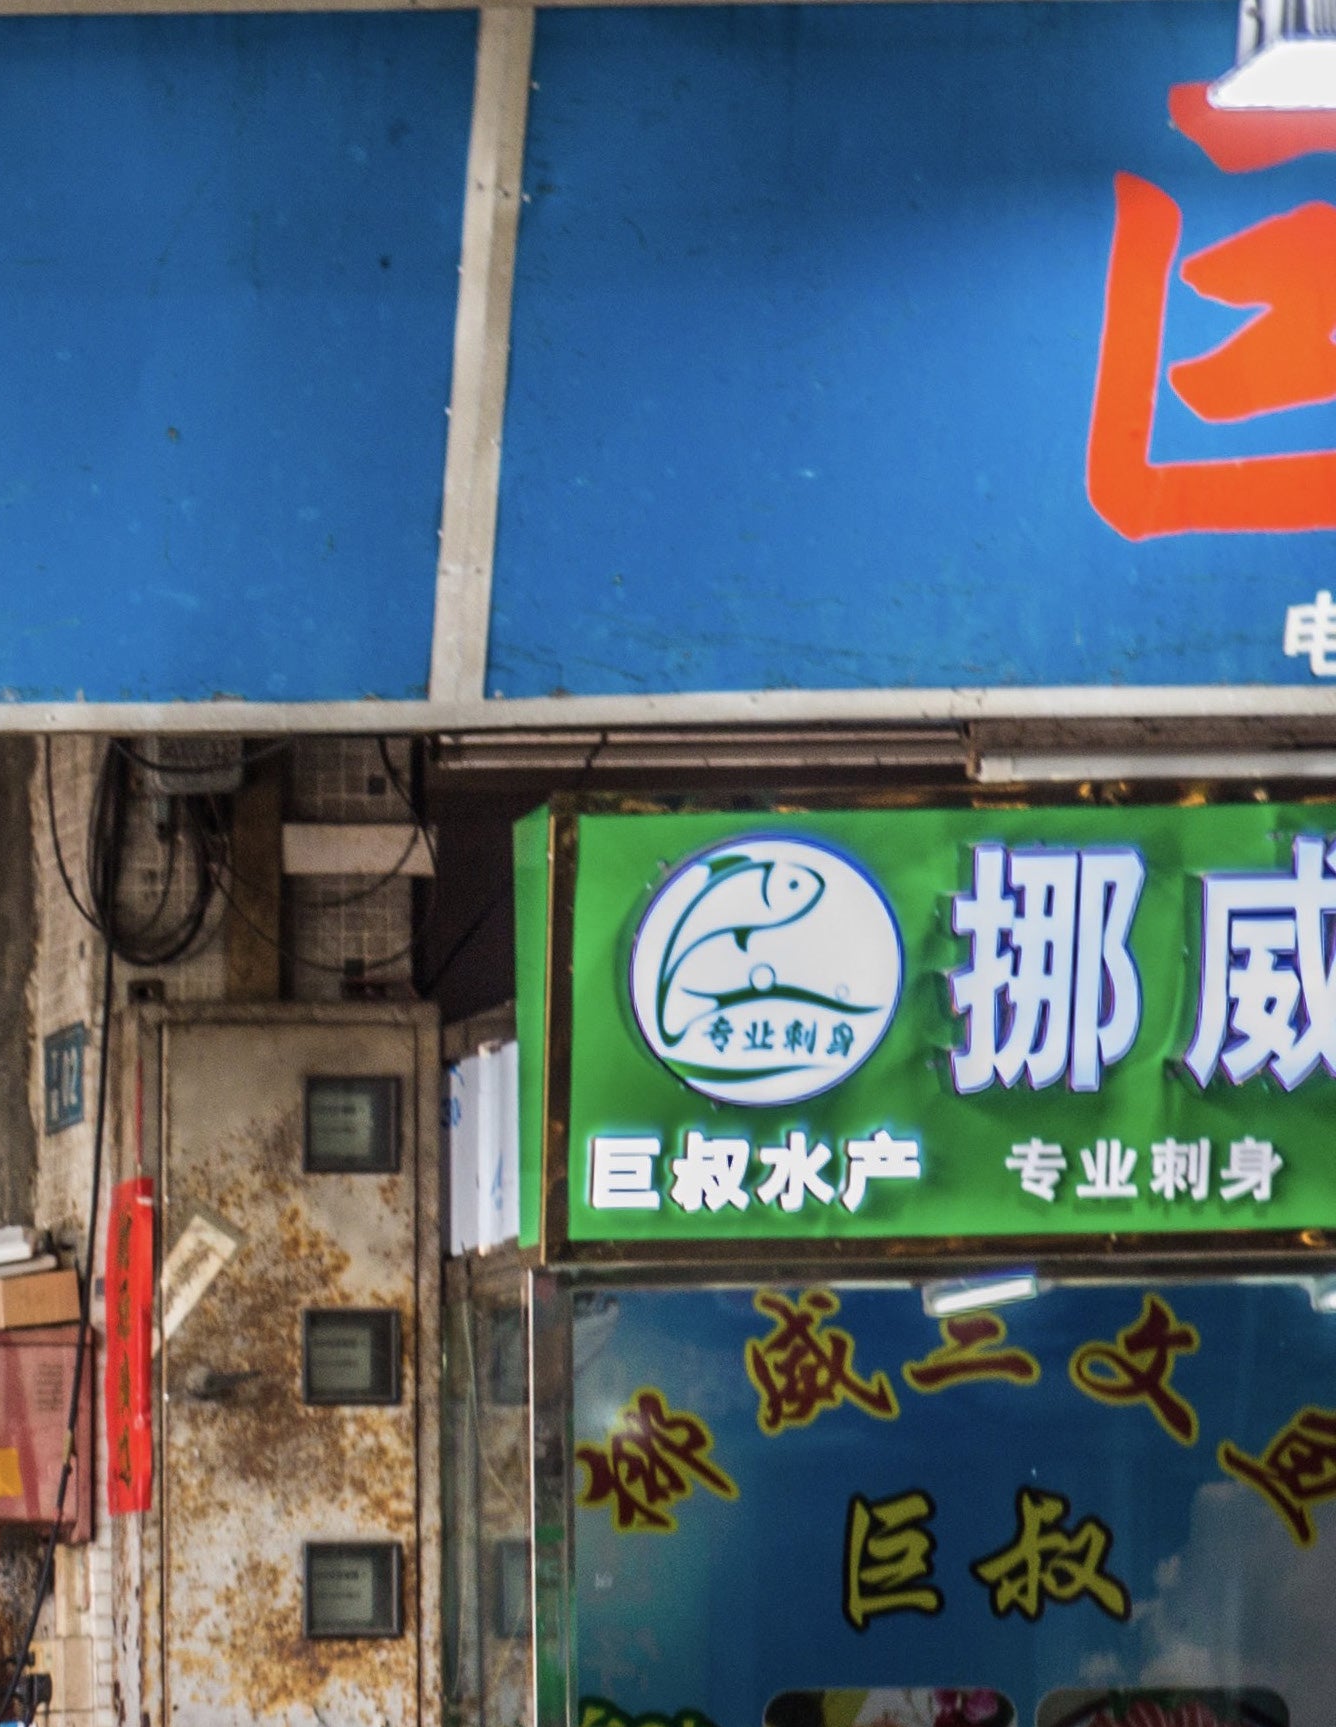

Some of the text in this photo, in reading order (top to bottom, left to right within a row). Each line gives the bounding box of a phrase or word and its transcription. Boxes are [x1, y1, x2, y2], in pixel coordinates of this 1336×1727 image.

[948, 837, 1336, 1093] 挪威
[704, 1015, 856, 1058] 专业刺身
[590, 1130, 921, 1212] 巨叔水产
[1005, 1136, 1284, 1203] 专业刺身
[846, 1494, 1130, 1624] 巨叔
